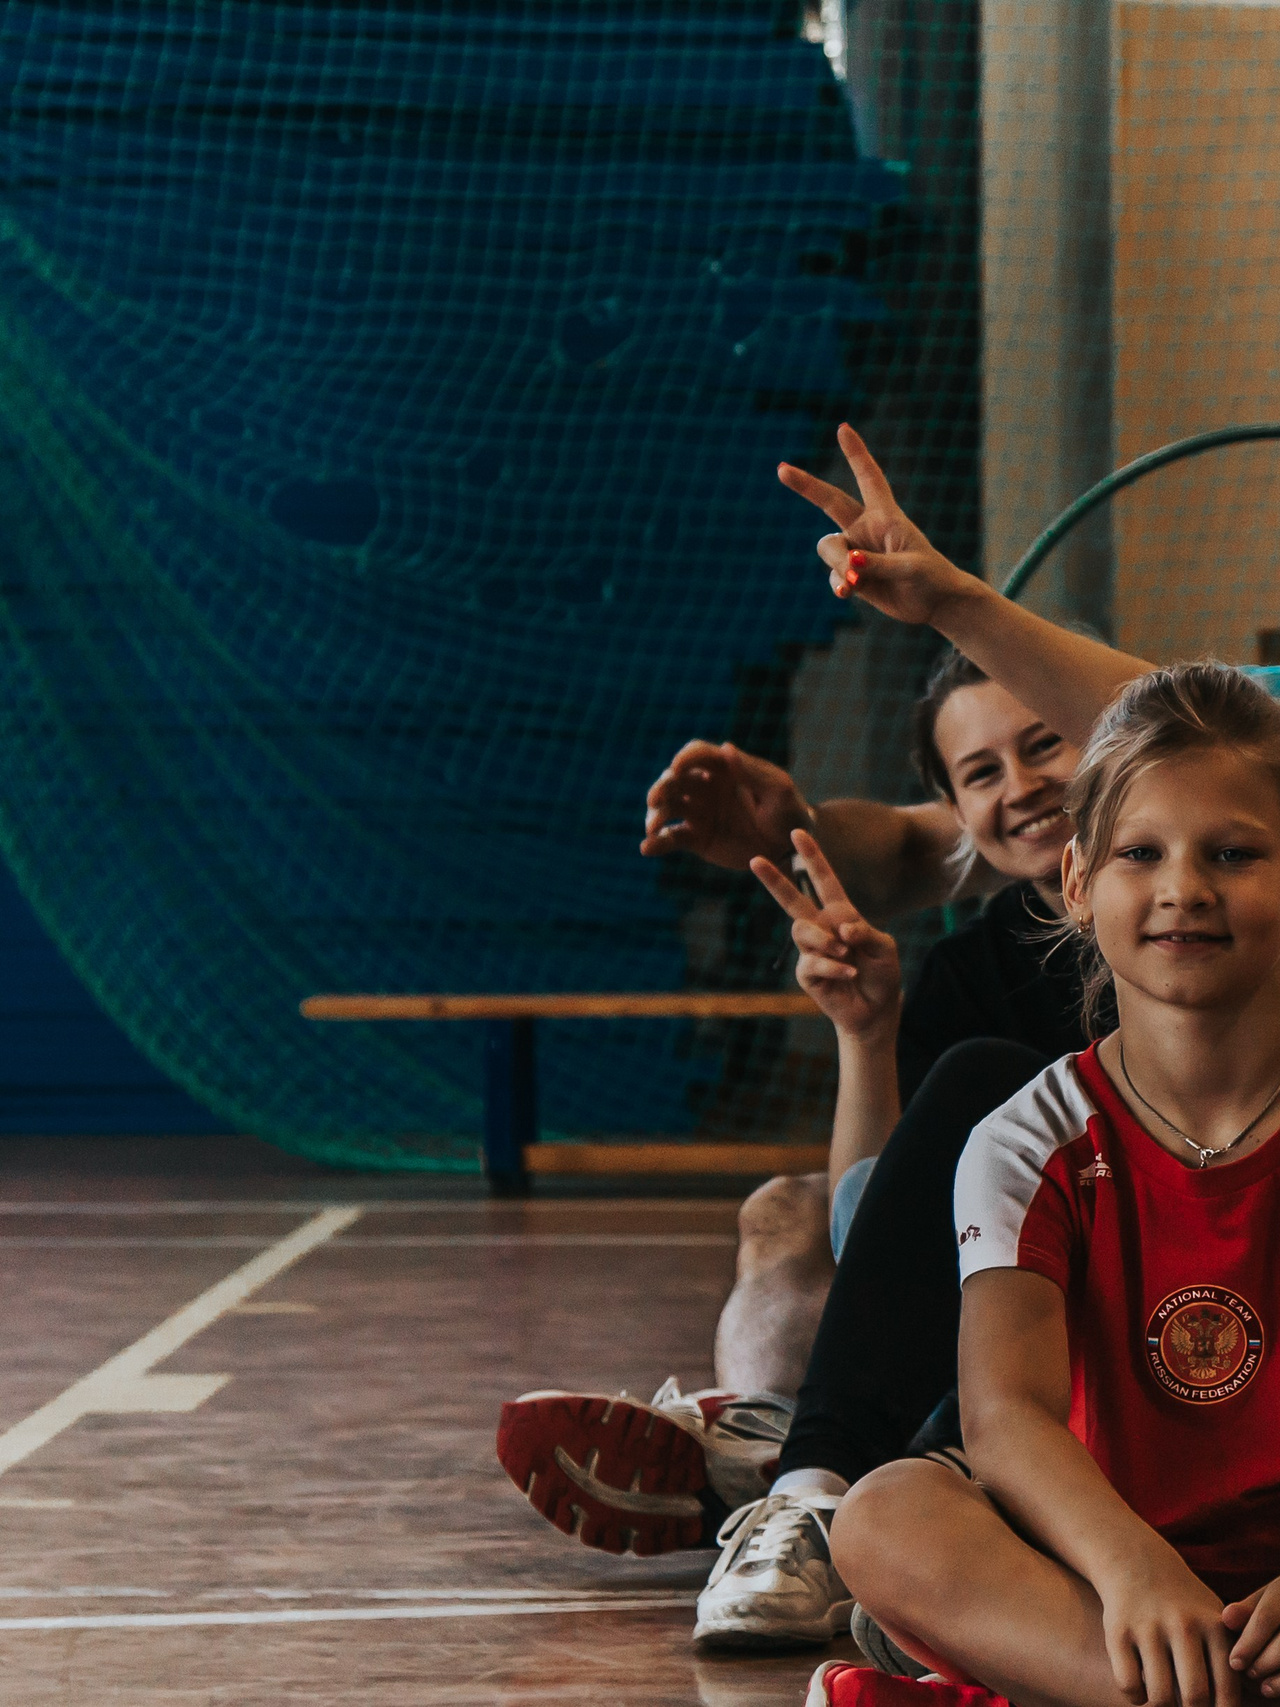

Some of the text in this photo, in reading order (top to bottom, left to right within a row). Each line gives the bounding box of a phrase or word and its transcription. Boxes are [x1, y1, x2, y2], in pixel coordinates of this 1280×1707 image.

[1158, 1290, 1253, 1322] NATIONAL TEAM
[1150, 1351, 1258, 1399] RUSSIAN FEDERATION
